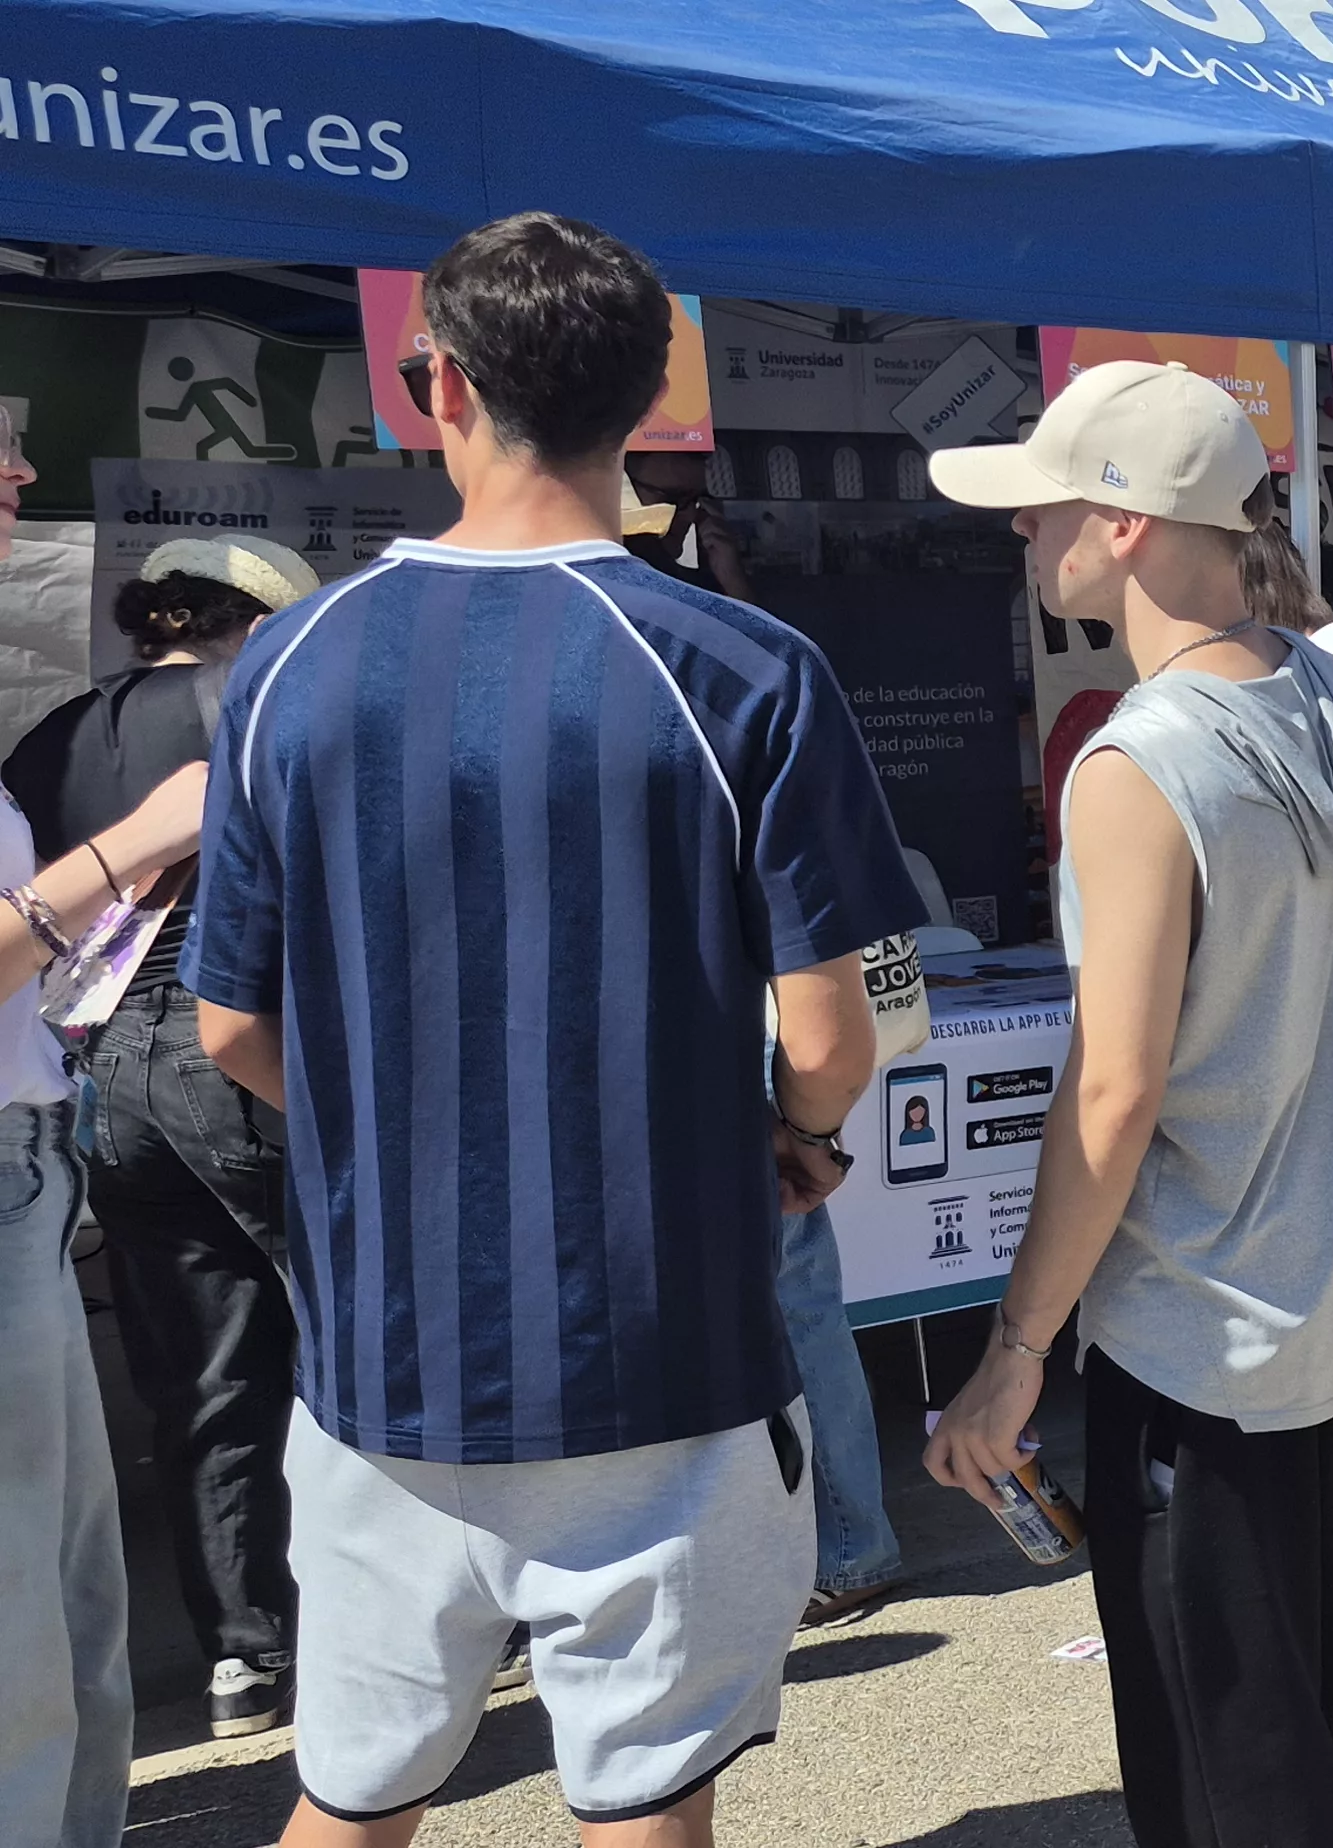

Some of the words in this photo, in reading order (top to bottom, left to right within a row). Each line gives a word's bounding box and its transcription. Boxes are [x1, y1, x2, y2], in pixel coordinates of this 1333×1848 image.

[758, 349, 844, 367] Universidad
[760, 366, 816, 381] Zaragoza
[1256, 380, 1266, 396] y
[124, 489, 269, 529] eduroam
[854, 686, 875, 704] de
[879, 685, 894, 703] la
[898, 682, 985, 702] educación
[863, 710, 950, 730] construye
[953, 709, 975, 725] en
[979, 706, 994, 724] la
[903, 732, 964, 754] pública
[878, 760, 929, 780] ragón
[930, 1018, 996, 1040] DESCARGA
[999, 1016, 1015, 1032] LA
[1018, 1012, 1042, 1030] APP
[1046, 1010, 1063, 1027] DE
[993, 1082, 1028, 1095] Google
[1028, 1079, 1048, 1091] Play
[993, 1129, 1017, 1143] App
[988, 1186, 1034, 1202] Servicio
[989, 1227, 997, 1239] y
